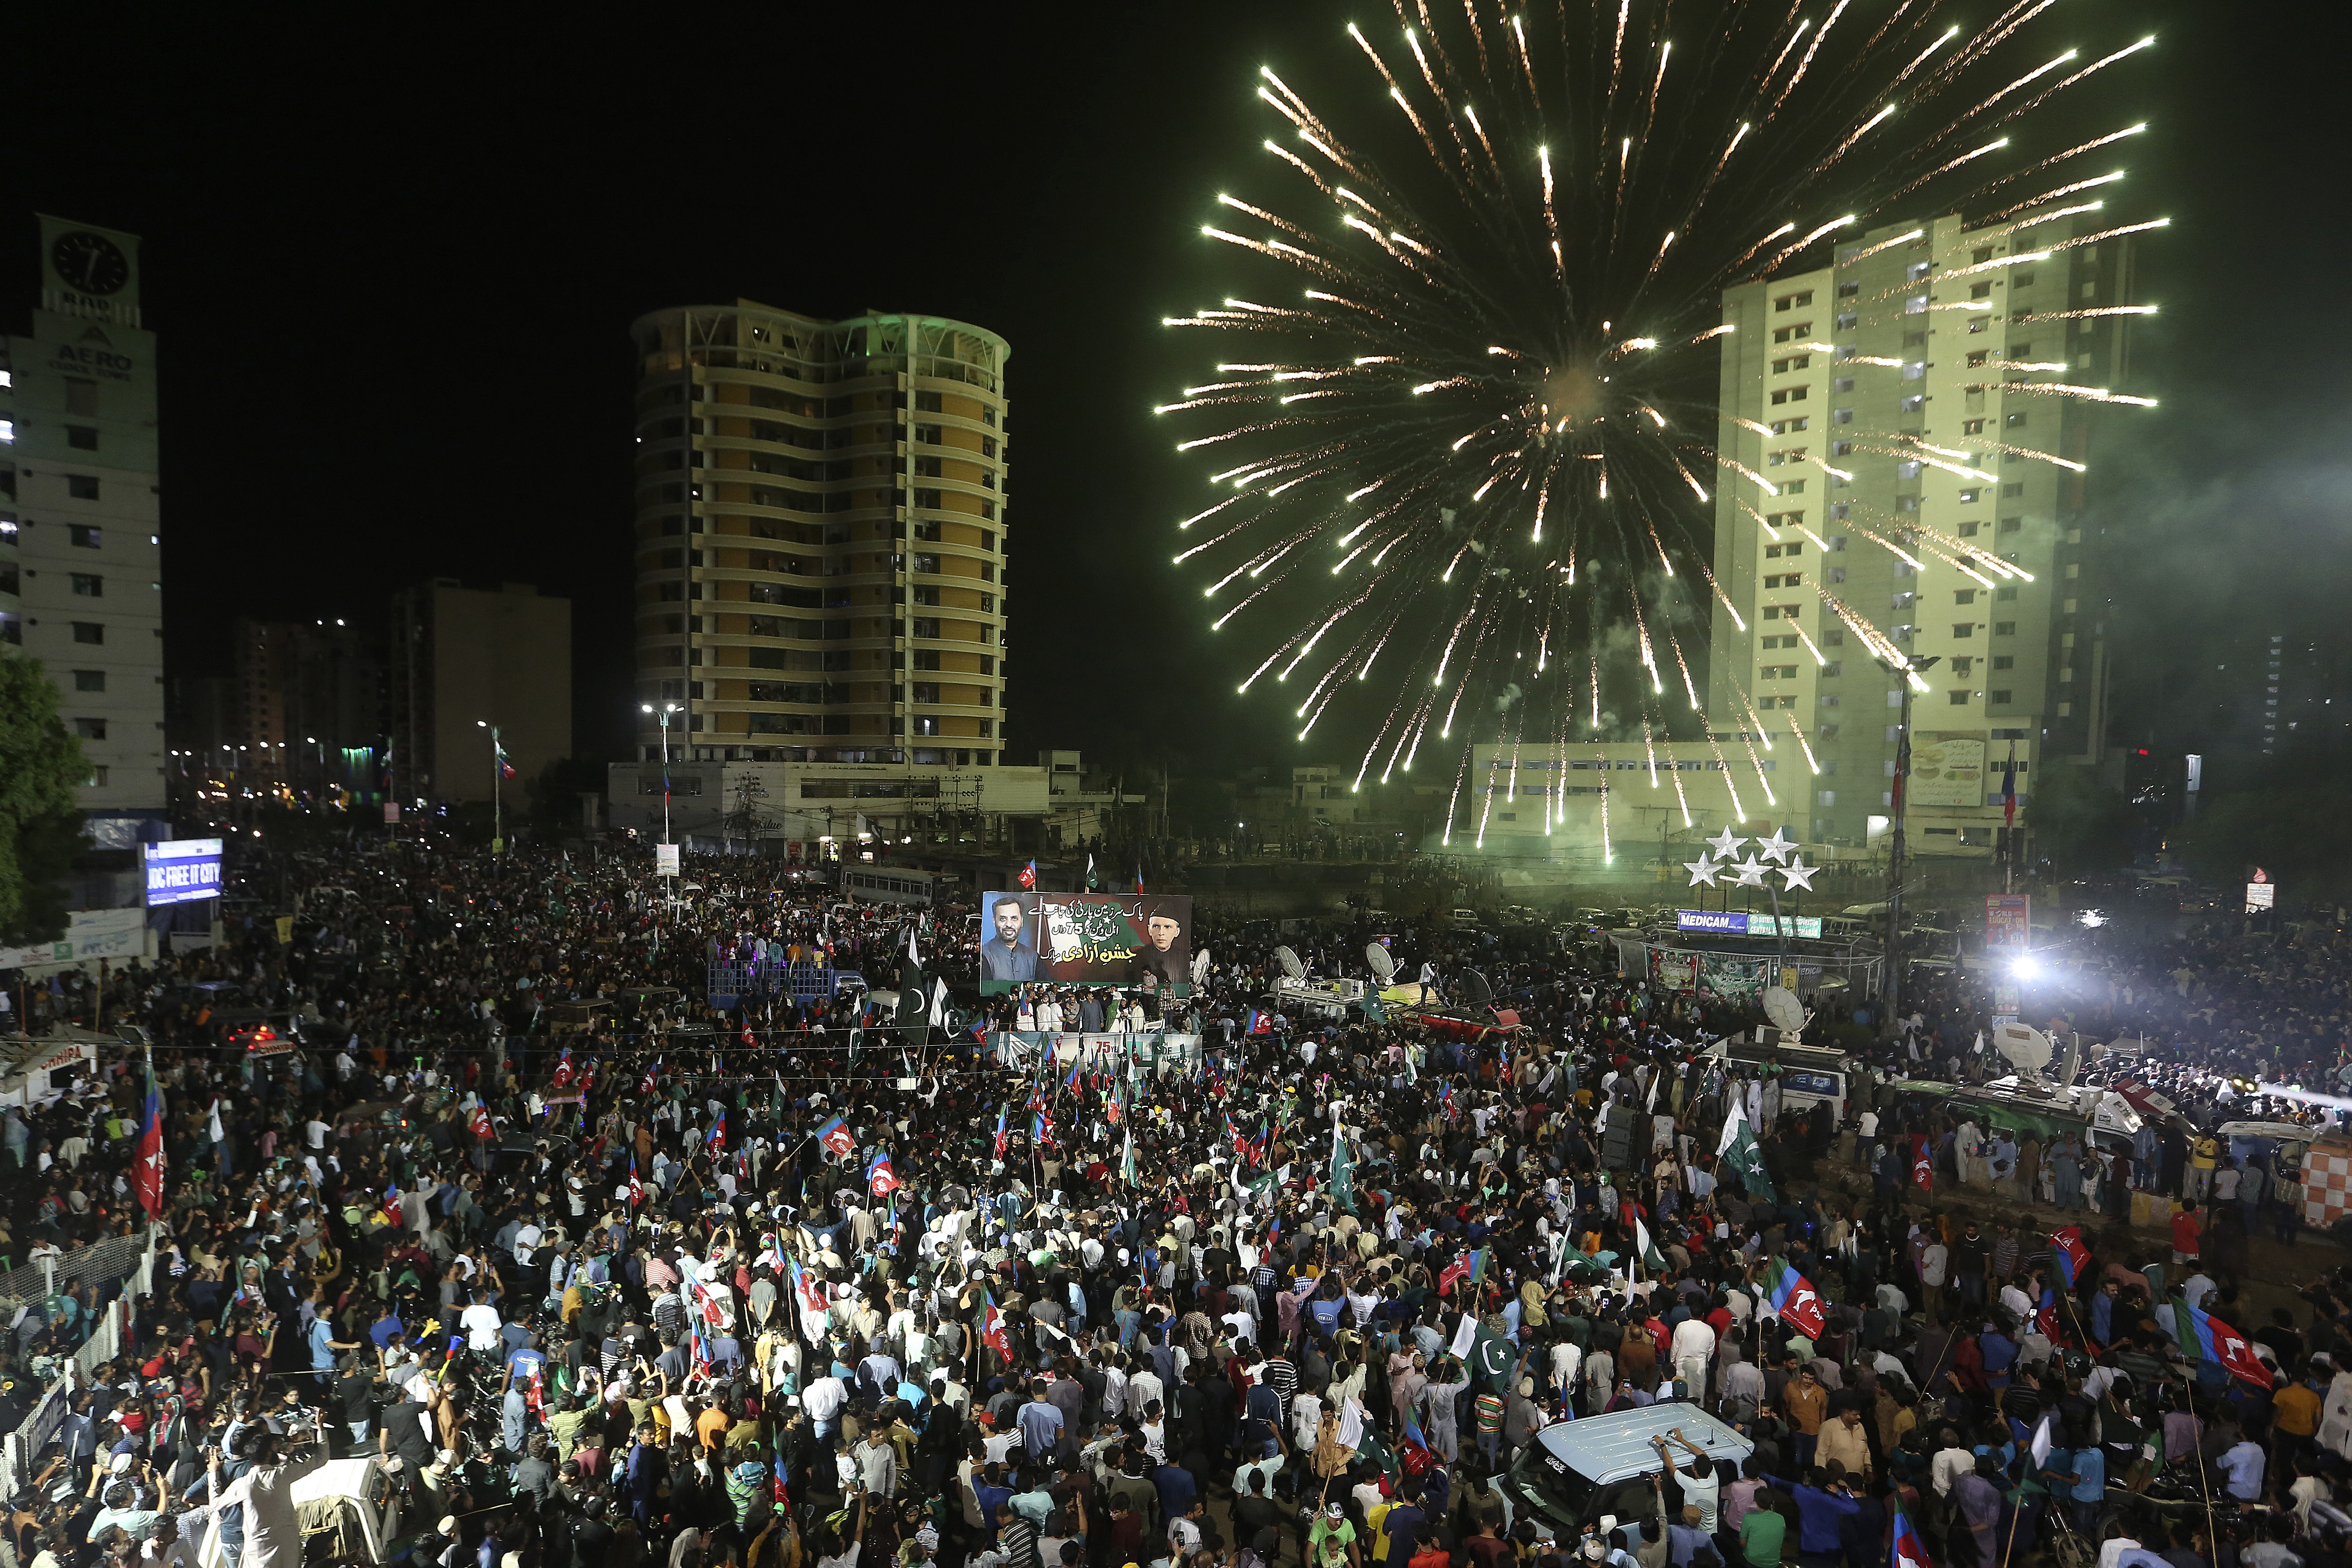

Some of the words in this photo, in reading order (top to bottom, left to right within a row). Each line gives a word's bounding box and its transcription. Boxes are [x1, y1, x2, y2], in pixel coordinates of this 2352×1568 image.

[59, 345, 132, 370] AERO
[166, 865, 190, 887] FREE
[190, 863, 201, 885] IT
[200, 862, 221, 884] CITY
[1028, 907, 1043, 915] سے
[1043, 904, 1065, 918] جانب
[1066, 899, 1076, 918] کی
[1076, 899, 1093, 919] پارٹی
[1122, 901, 1144, 921] پاک
[1066, 922, 1084, 934] 75
[1680, 914, 1730, 928] MEDICAM
[1052, 925, 1066, 935] واں
[1084, 922, 1093, 935] کو
[1089, 920, 1104, 937] وطن
[1750, 926, 1772, 934] CENTRAL
[1040, 948, 1060, 961] مبارک
[1062, 940, 1099, 964] آزادی
[1096, 1041, 1110, 1054] 75
